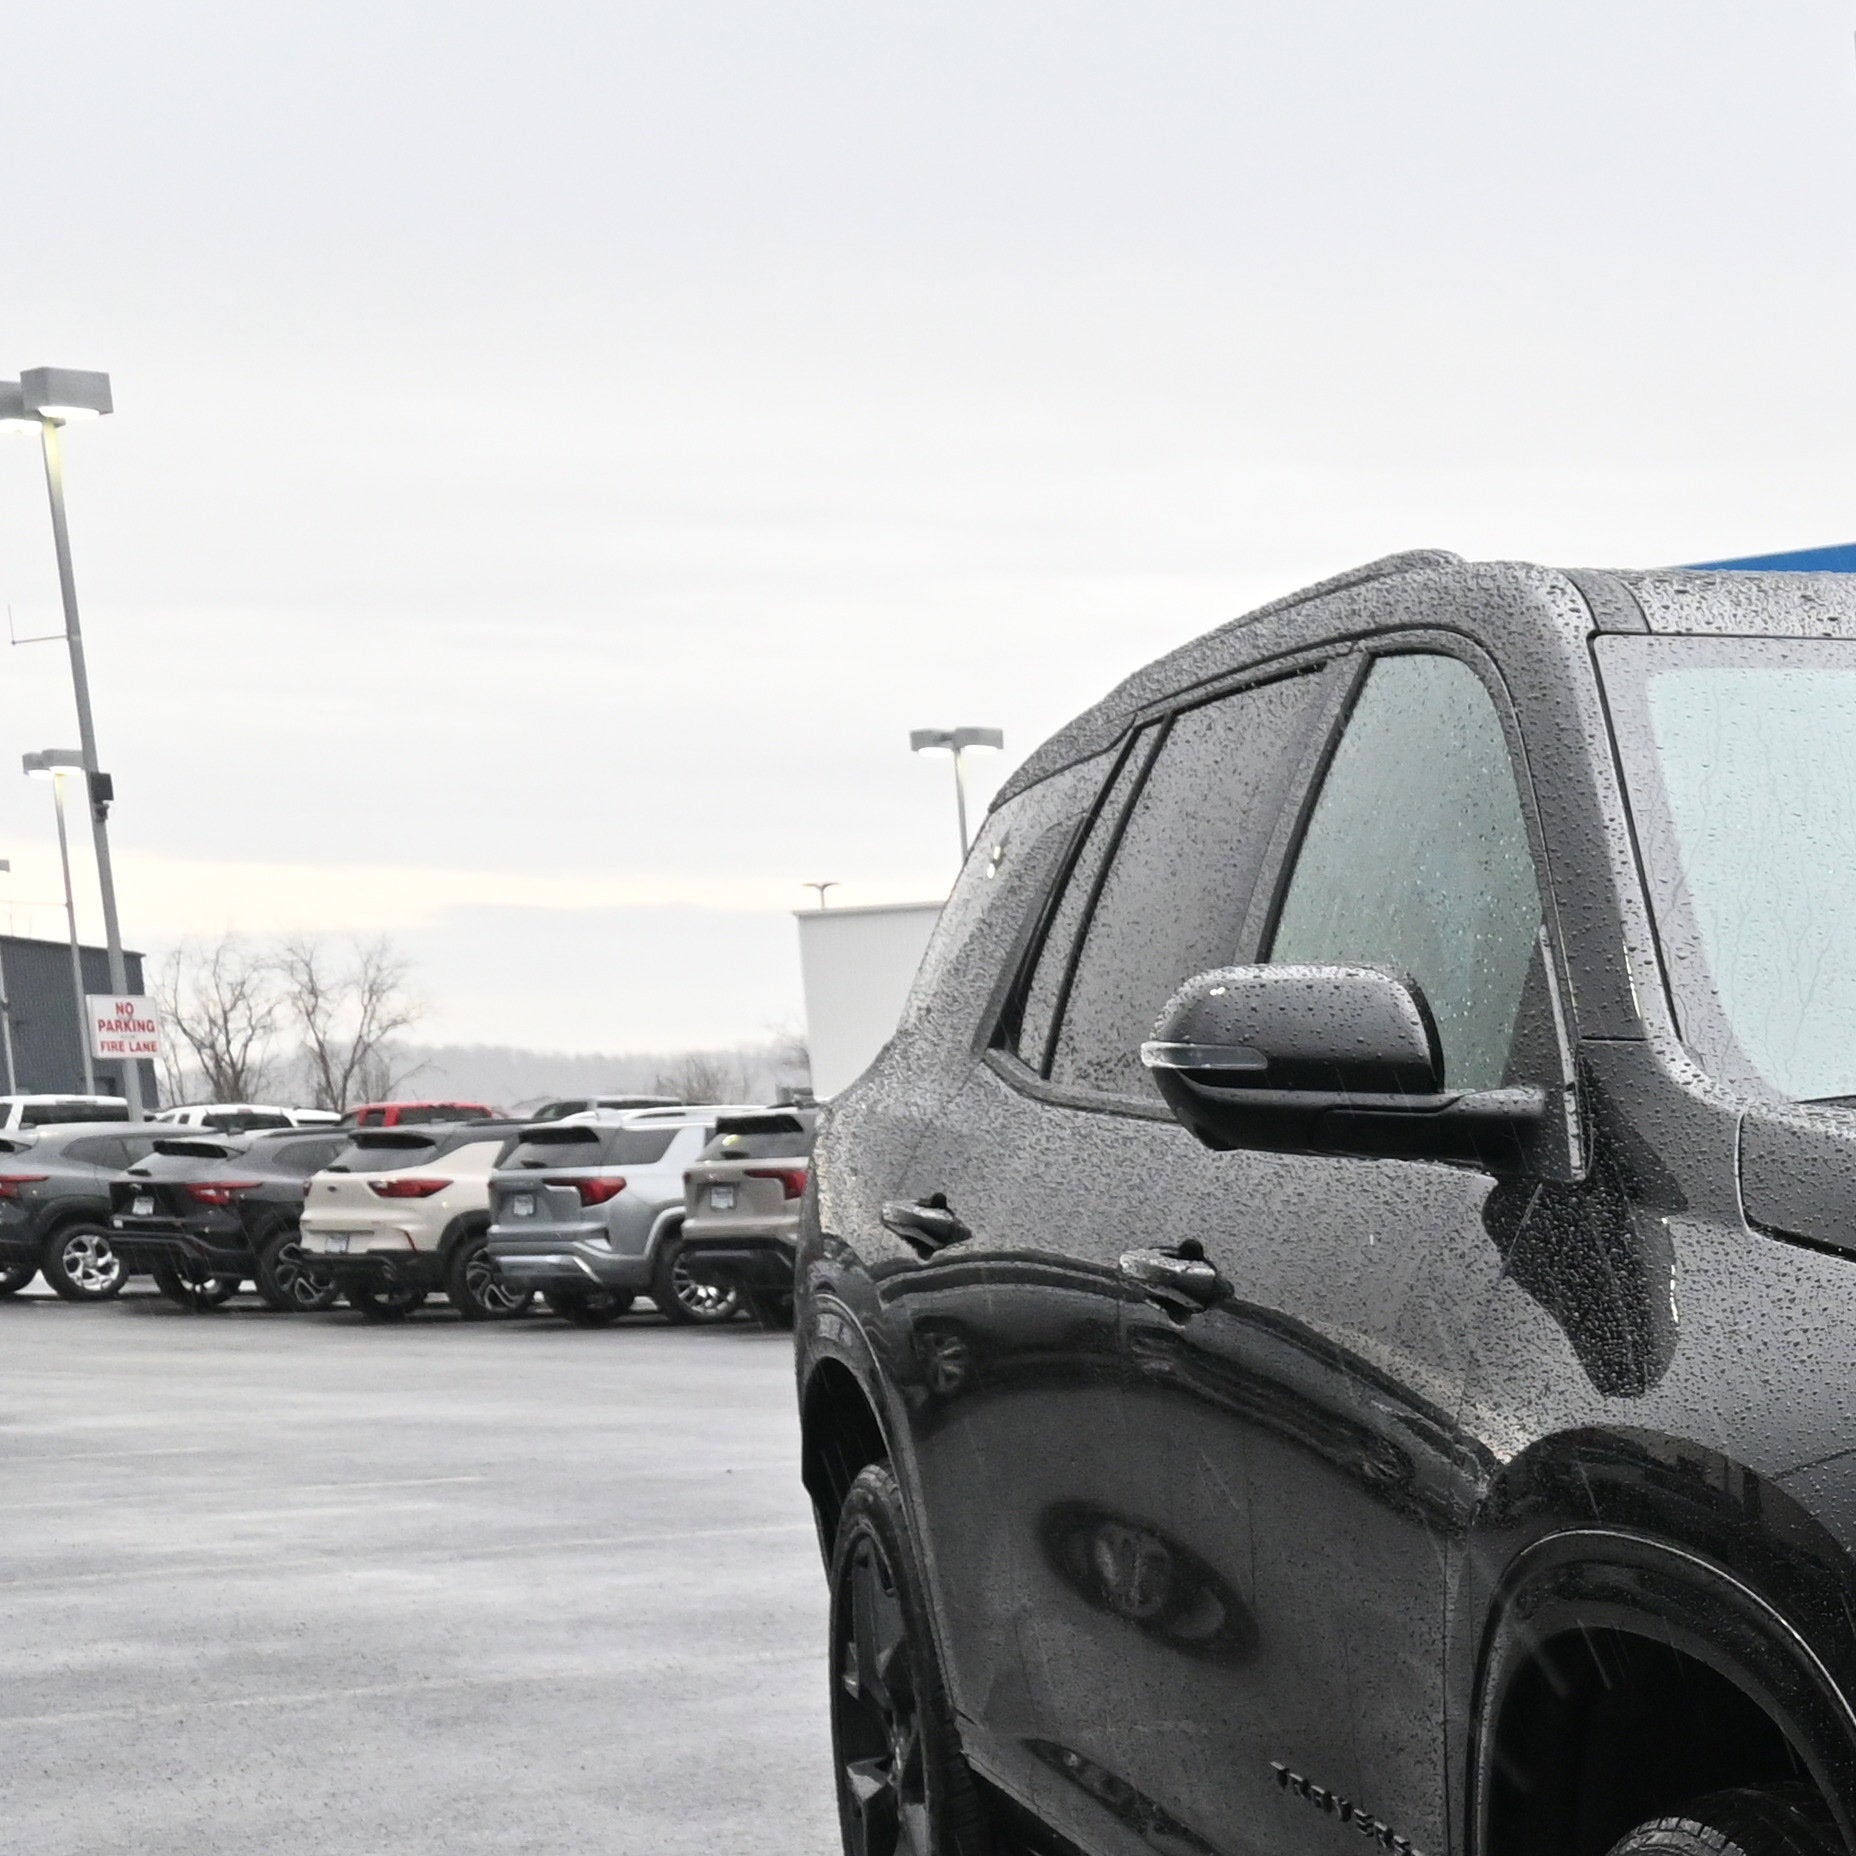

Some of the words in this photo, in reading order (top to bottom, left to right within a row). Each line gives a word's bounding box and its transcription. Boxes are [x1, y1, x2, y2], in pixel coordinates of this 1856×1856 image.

[115, 1002, 134, 1015] NO
[98, 1019, 155, 1032] PARKING
[100, 1041, 125, 1052] FIRE
[128, 1041, 158, 1052] LANE
